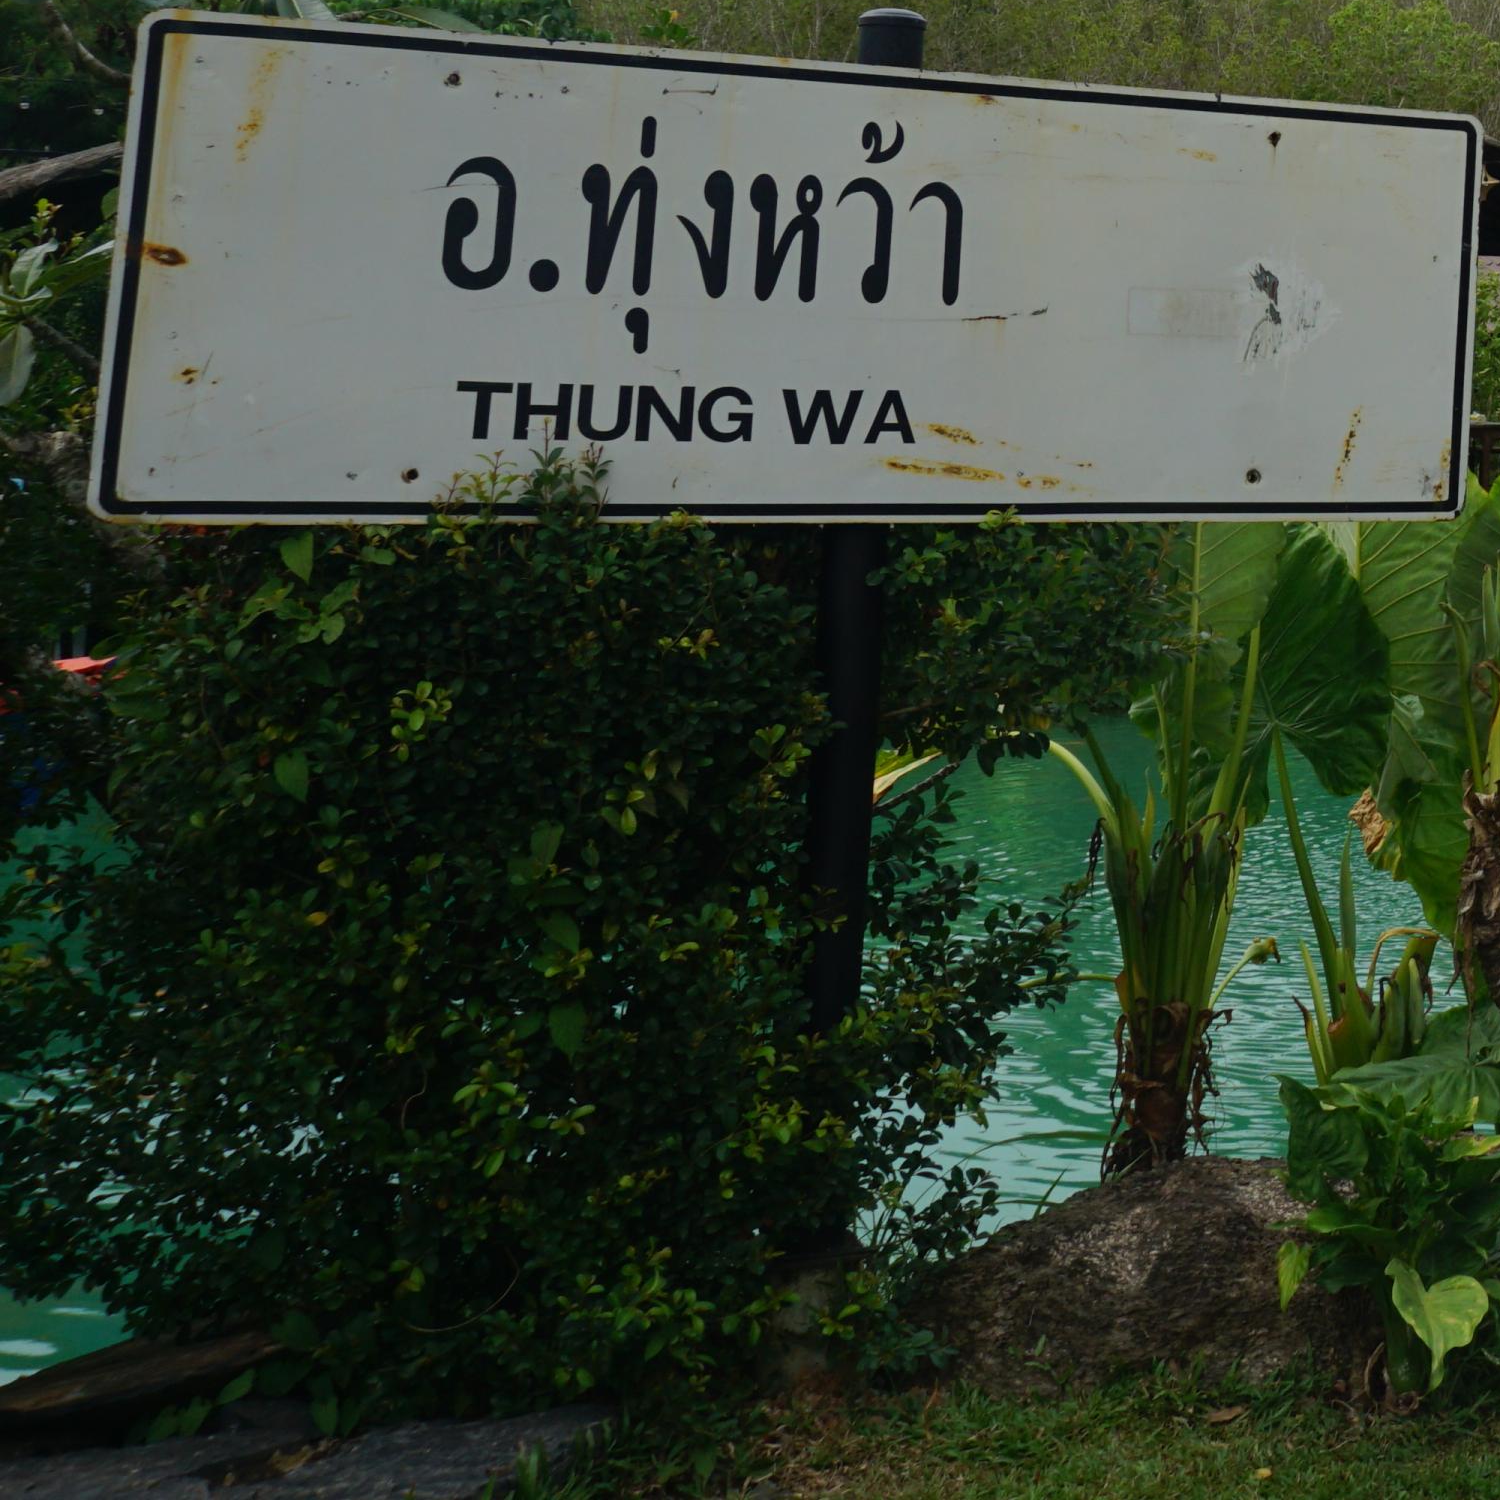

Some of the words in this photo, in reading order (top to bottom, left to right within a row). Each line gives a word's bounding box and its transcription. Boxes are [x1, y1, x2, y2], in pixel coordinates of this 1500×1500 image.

[441, 115, 964, 354] อ.ทุ่งหว้า
[456, 380, 754, 443] THUNG
[782, 389, 916, 445] WA
